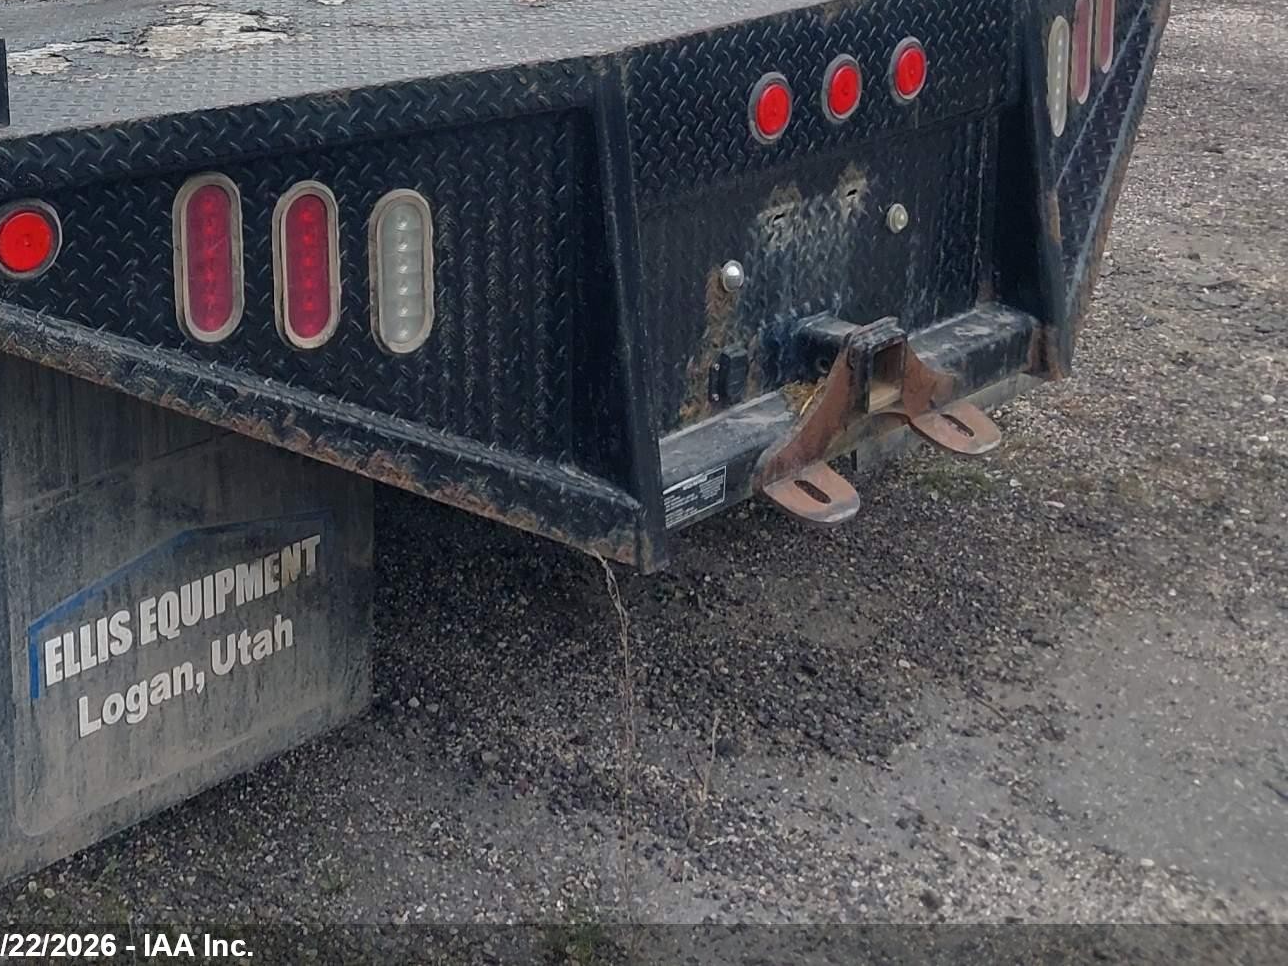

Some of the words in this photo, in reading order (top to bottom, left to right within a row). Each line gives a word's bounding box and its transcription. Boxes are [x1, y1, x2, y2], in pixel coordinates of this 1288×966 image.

[44, 609, 132, 687] ELLIS
[140, 534, 321, 646] EQUIPMENT
[78, 660, 205, 739] Logan,
[211, 613, 294, 676] Utah
